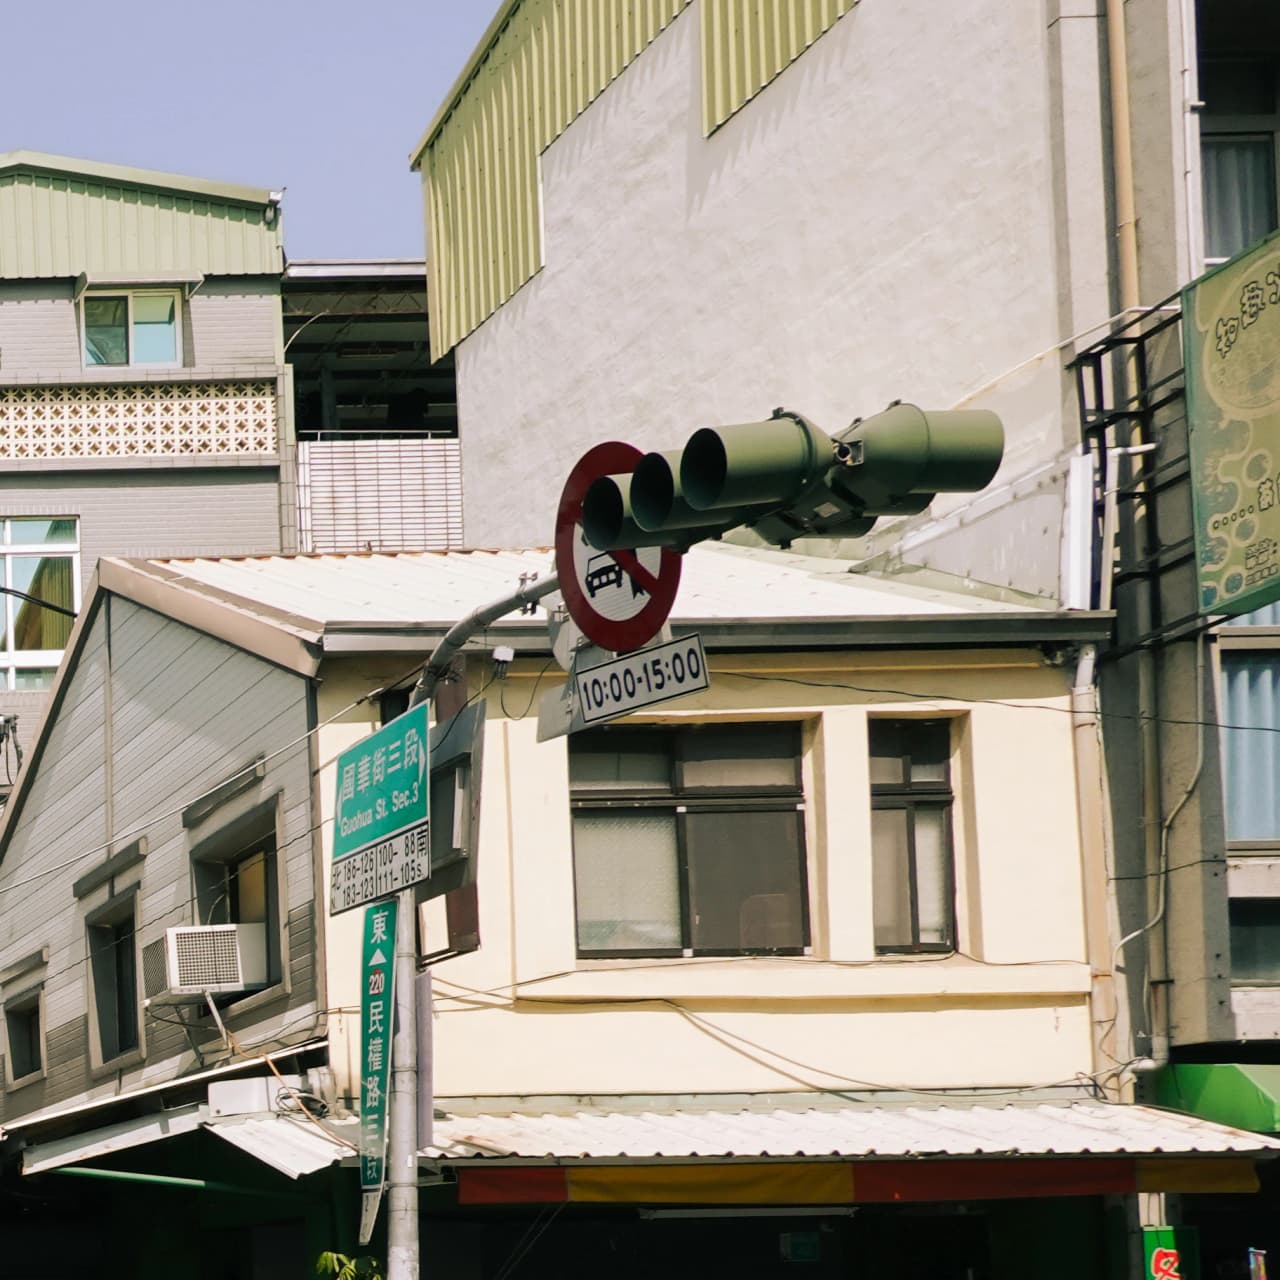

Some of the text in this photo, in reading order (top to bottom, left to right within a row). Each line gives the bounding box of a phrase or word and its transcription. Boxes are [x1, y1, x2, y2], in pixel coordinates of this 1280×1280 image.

[581, 646, 701, 712] 10:00-15:00
[342, 728, 419, 803] 國華街三段
[341, 783, 419, 837] Guohua St. Sec.3
[404, 832, 415, 857] 88
[416, 827, 428, 859] 南
[370, 911, 389, 944] 東
[366, 1000, 384, 1182] 民權路三段
